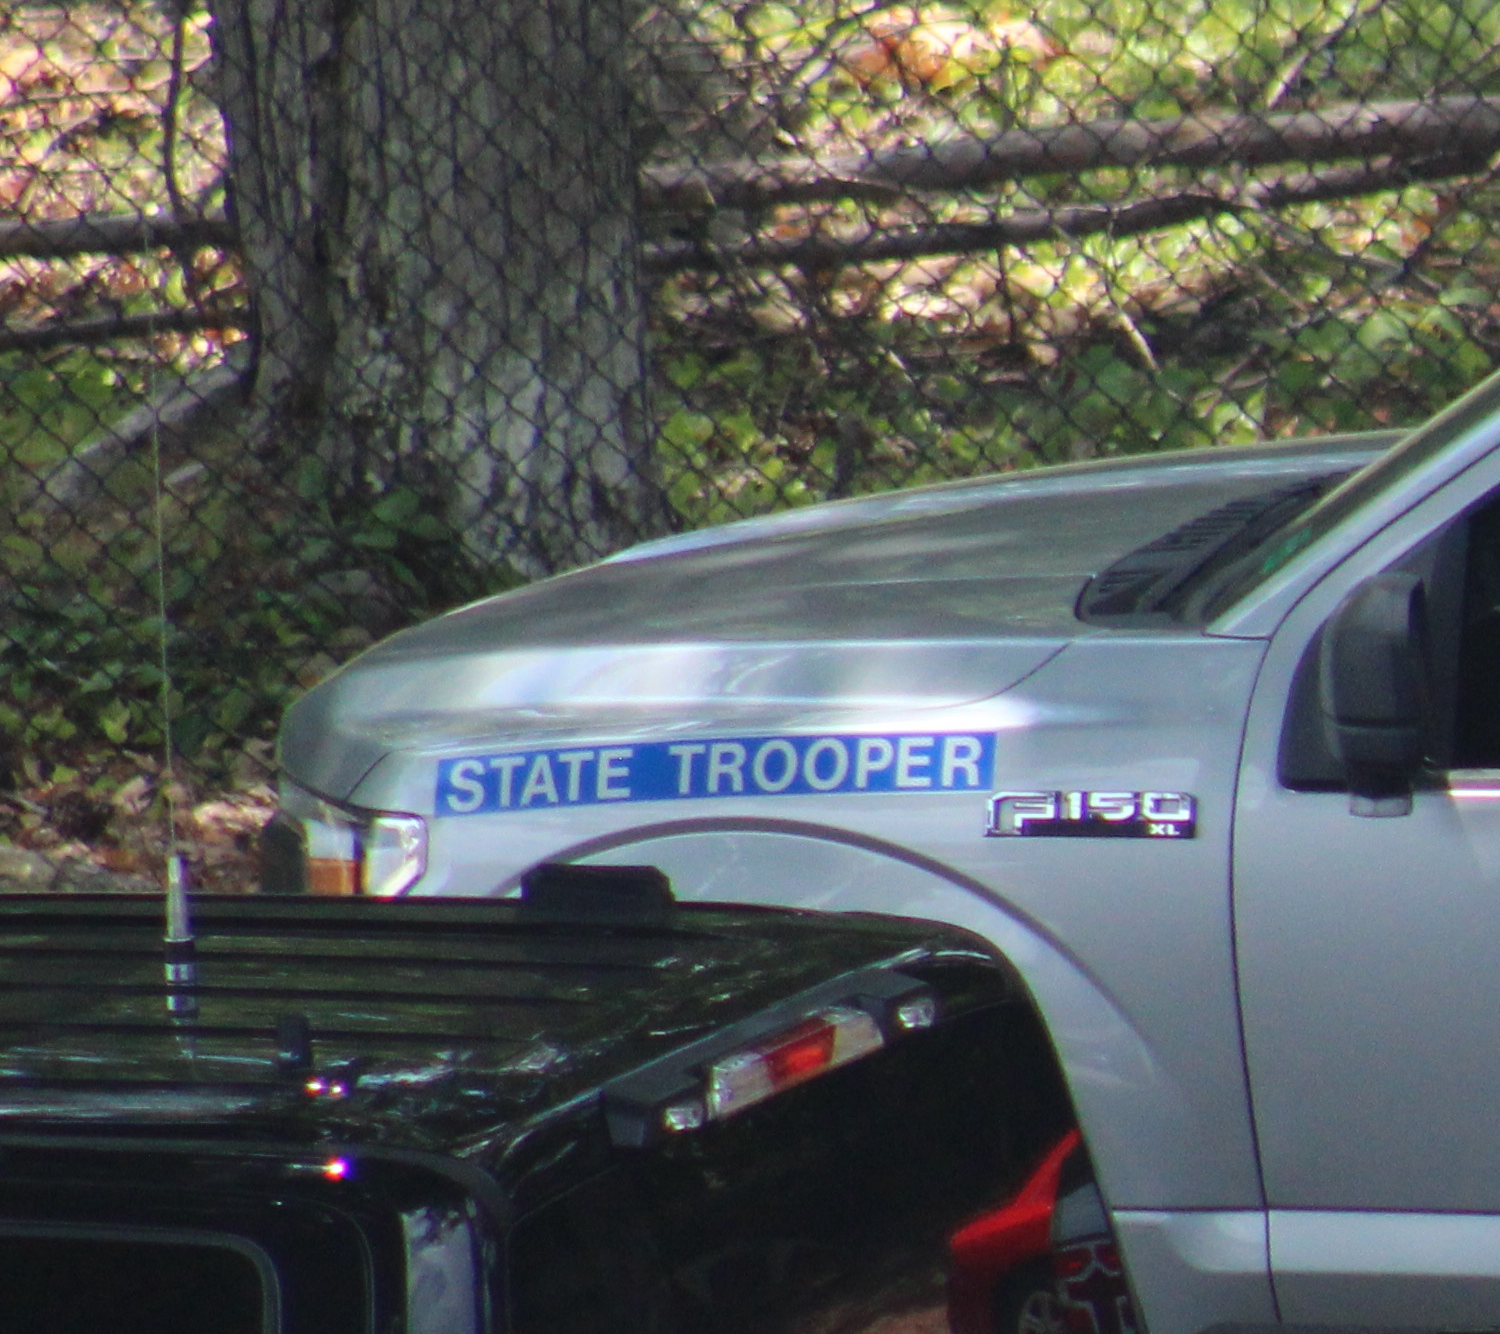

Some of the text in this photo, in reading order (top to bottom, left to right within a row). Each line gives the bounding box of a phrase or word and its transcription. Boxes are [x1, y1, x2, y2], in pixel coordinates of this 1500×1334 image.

[447, 733, 983, 813] STATE TROOPER
[1149, 823, 1181, 836] XL
